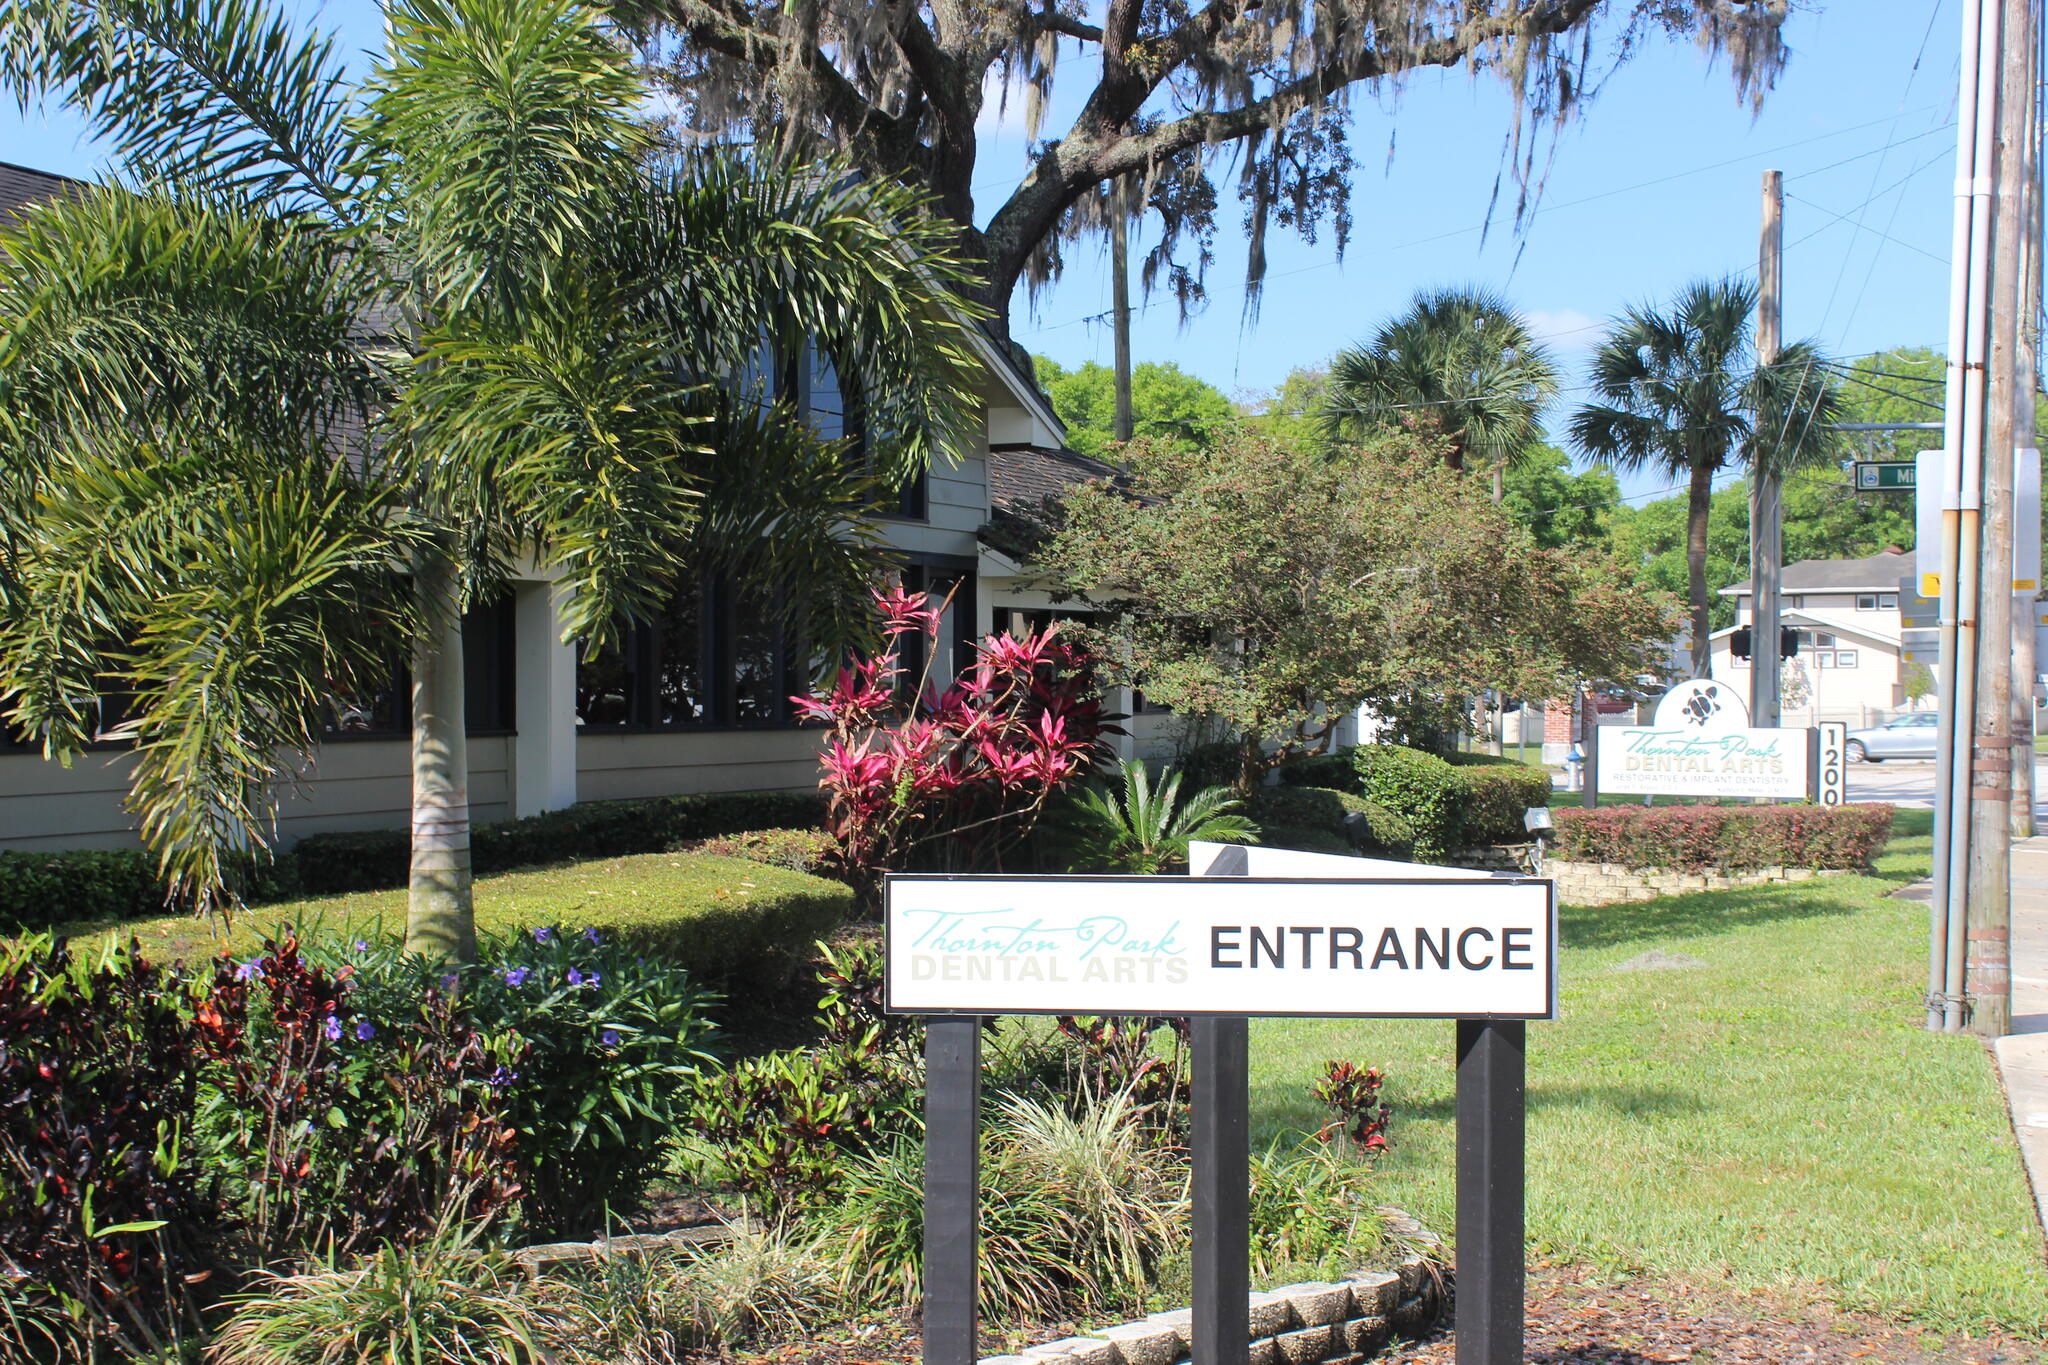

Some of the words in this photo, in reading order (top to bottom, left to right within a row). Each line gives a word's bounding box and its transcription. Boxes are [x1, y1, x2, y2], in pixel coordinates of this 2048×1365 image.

[1622, 730, 1728, 756] Thornton
[1719, 734, 1782, 761] Park
[1613, 773, 1678, 783] RESTORATIVE
[1691, 775, 1732, 784] IMPLANT
[1735, 776, 1789, 785] DENTISTRY
[1625, 755, 1714, 773] DENTAL
[1721, 757, 1783, 775] ARTS
[1824, 729, 1839, 806] 1200
[903, 908, 1093, 957] Thornton
[1076, 915, 1187, 961] Park
[1211, 926, 1534, 971] ENTRANCE
[911, 955, 1068, 982] DENTAL
[1081, 957, 1189, 984] ARTS
